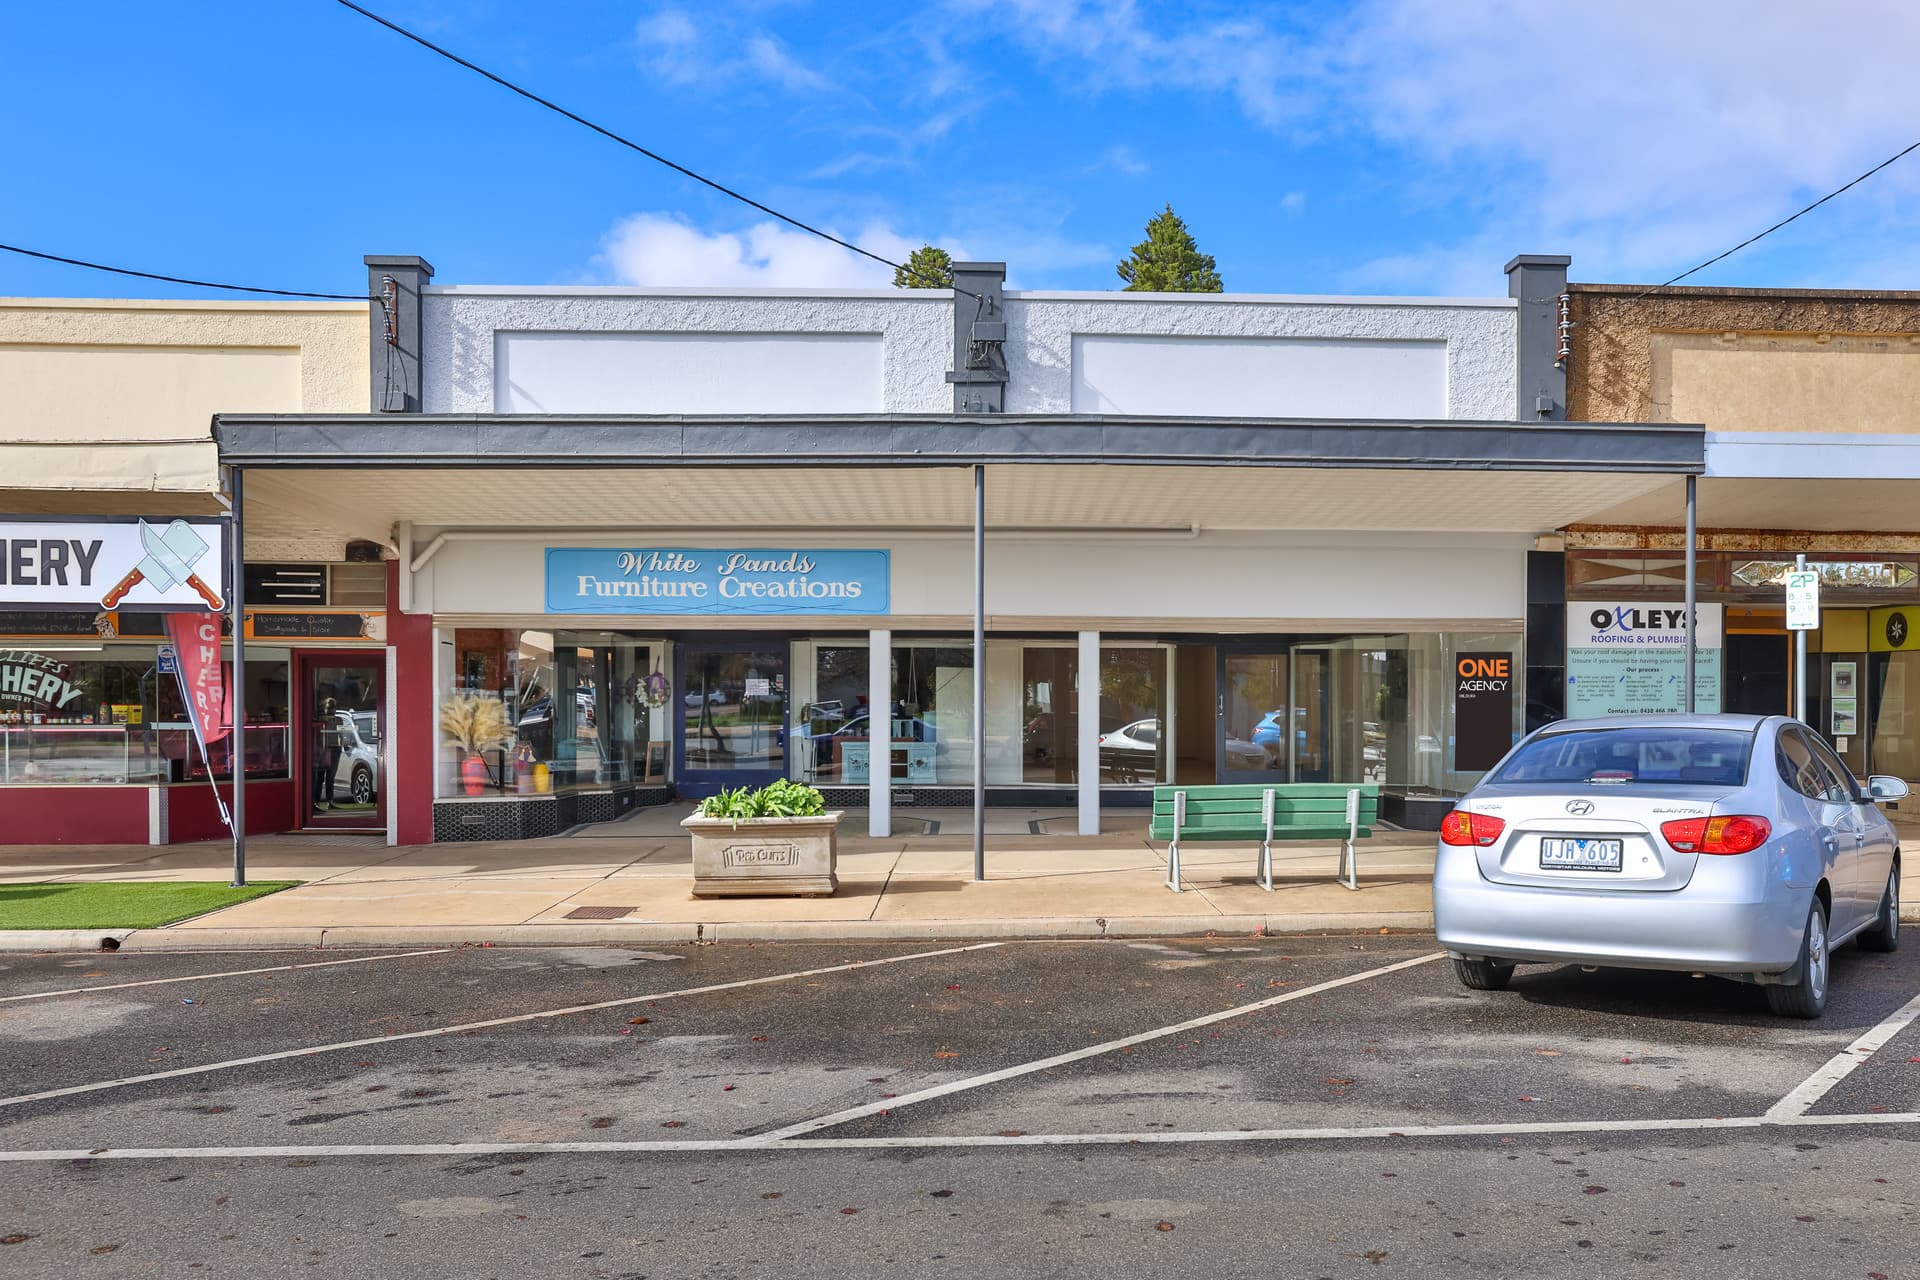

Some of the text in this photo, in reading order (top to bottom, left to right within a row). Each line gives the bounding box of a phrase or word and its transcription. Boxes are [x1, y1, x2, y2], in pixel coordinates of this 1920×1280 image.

[0, 539, 103, 586] ERY
[617, 551, 701, 576] White
[576, 575, 862, 599] Furniture Creations
[1790, 574, 1815, 588] 2P
[1591, 635, 1697, 644] ROOFING & PLUMBI
[1611, 649, 1637, 657] damaged
[1458, 658, 1509, 678] ONE
[0, 664, 83, 710] HERY
[1459, 680, 1508, 691] AGENCY
[1, 693, 32, 704] OWNED BY
[1652, 807, 1705, 815] ELANTRA
[1544, 841, 1618, 861] UJH 605
